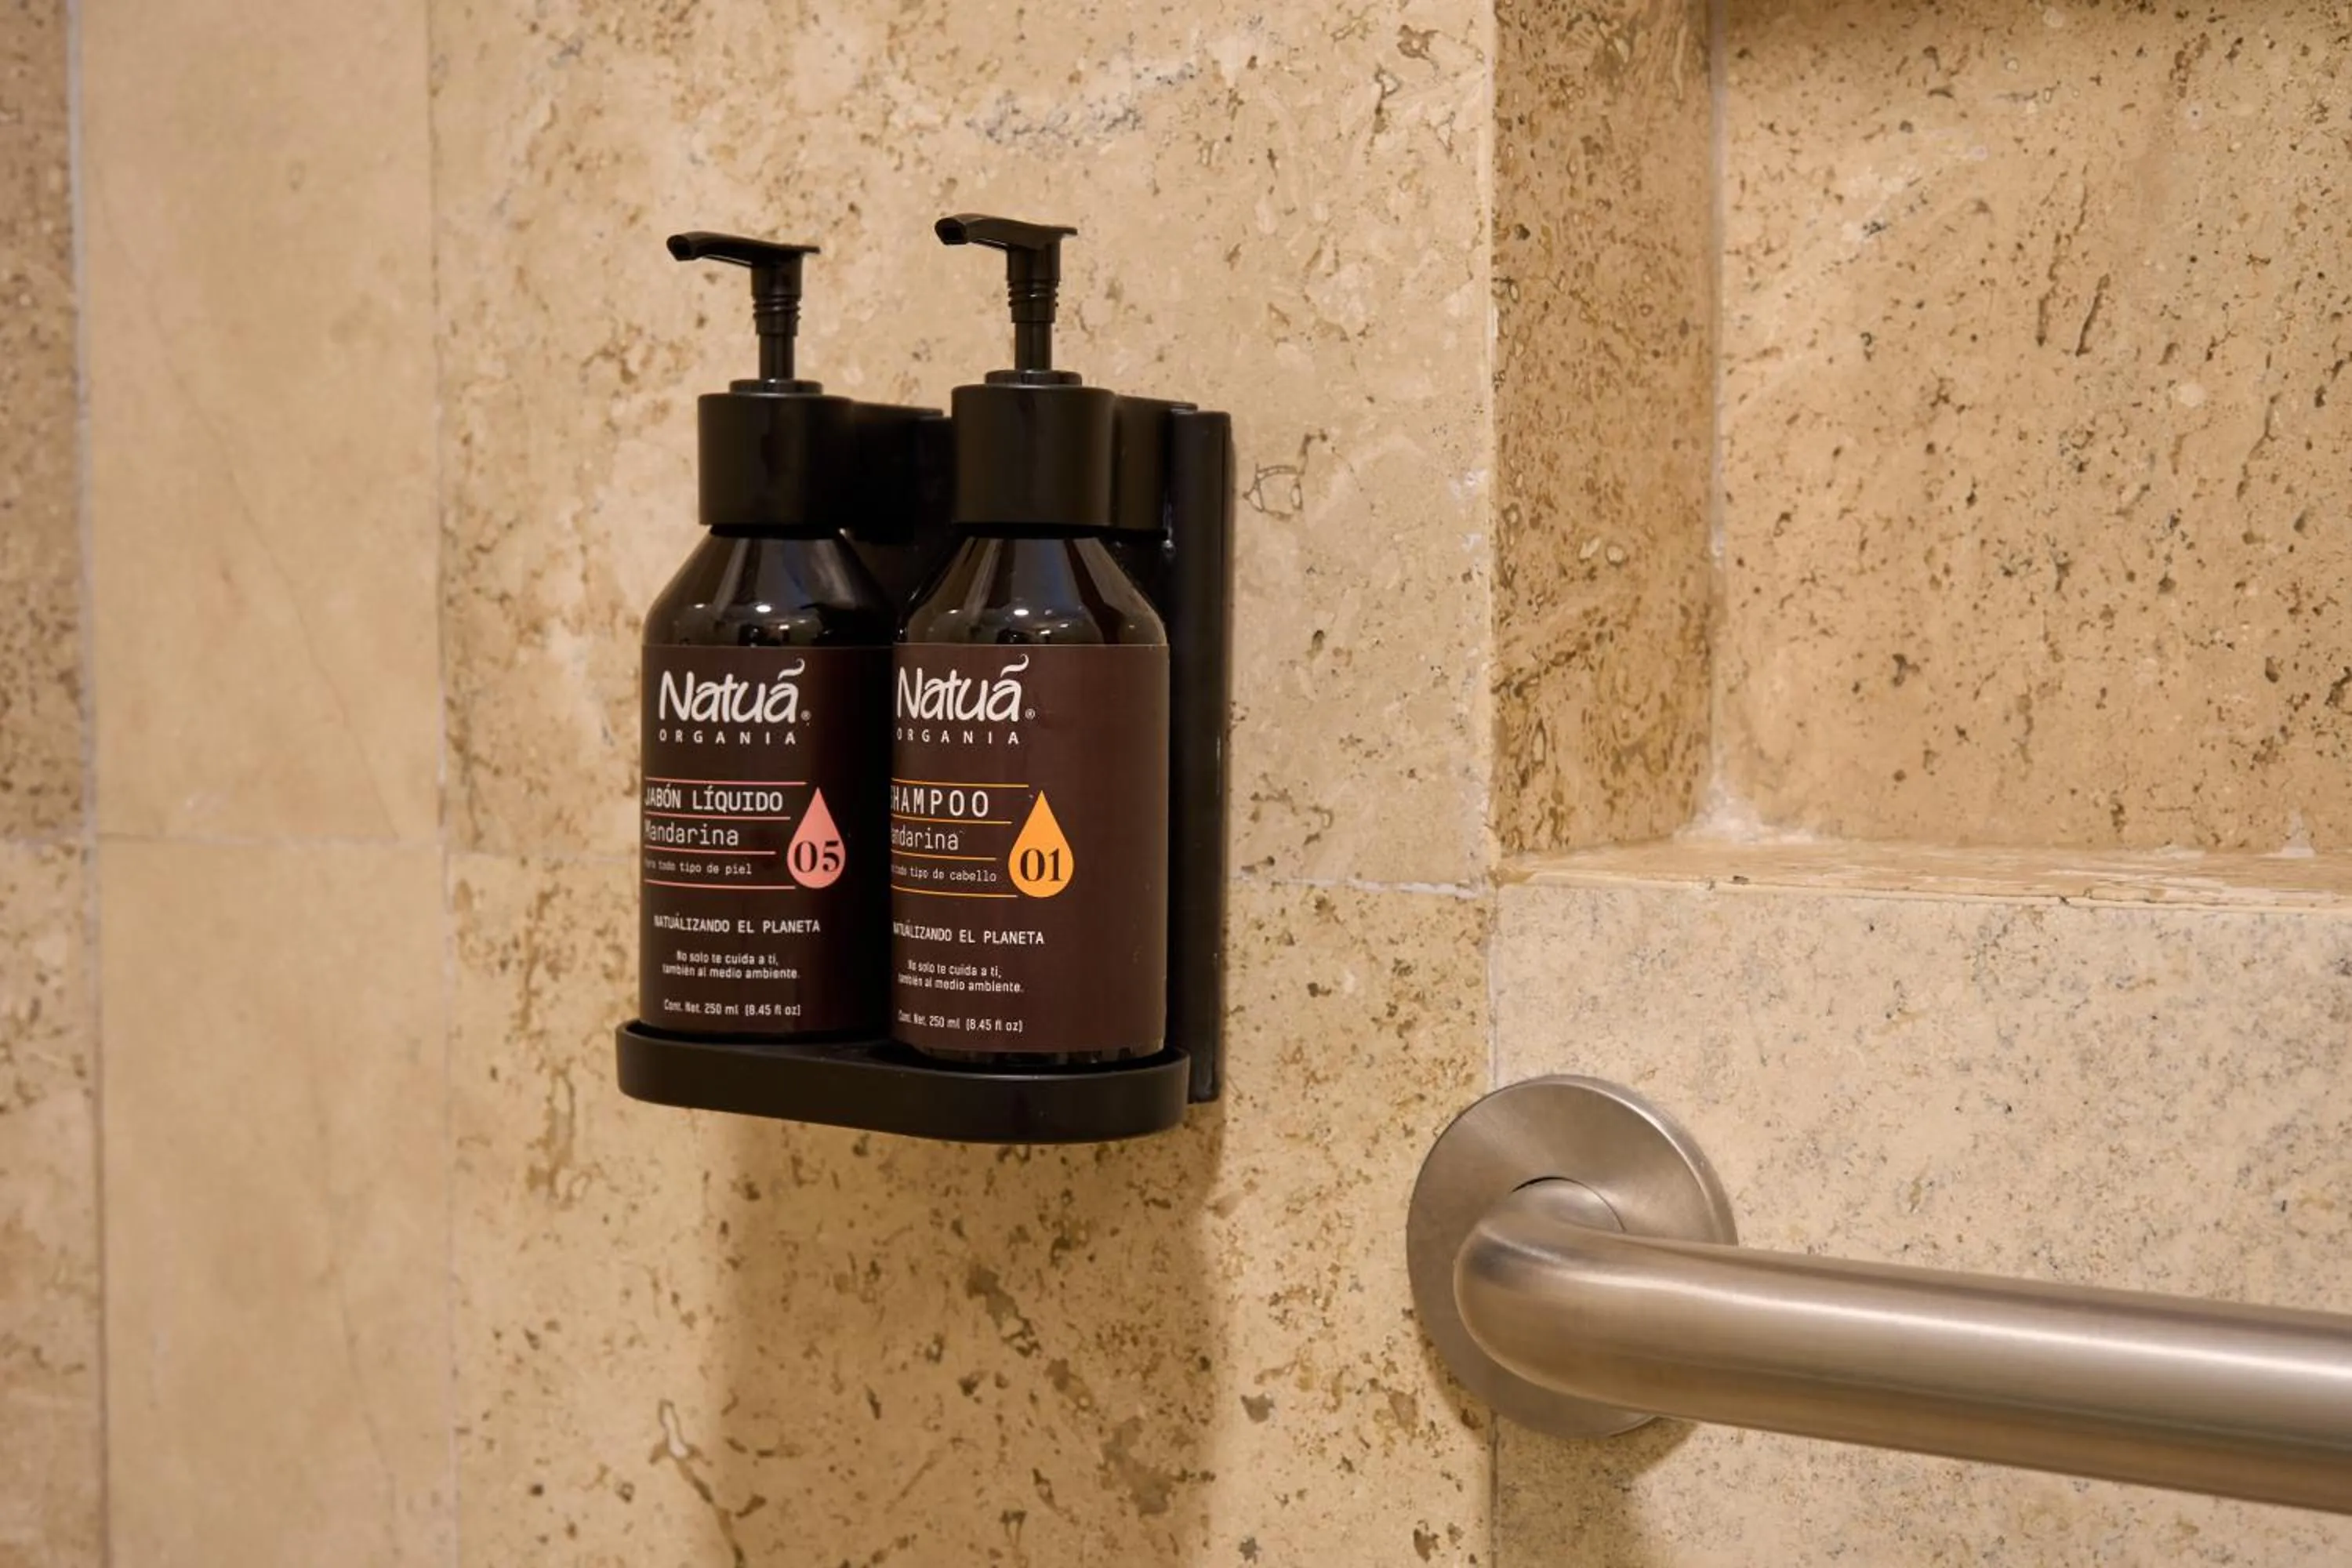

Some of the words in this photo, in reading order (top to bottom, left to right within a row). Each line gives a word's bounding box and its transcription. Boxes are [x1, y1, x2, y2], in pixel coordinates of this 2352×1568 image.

[659, 728, 796, 745] ORGANIA
[896, 727, 1019, 744] ORGANIA
[644, 782, 681, 809] JABÓN
[692, 785, 783, 813] LÍQUIDO
[794, 840, 840, 873] 05
[1020, 848, 1062, 882] 01
[679, 861, 702, 874] tipo
[707, 862, 720, 873] de
[725, 863, 753, 876] piel
[910, 866, 929, 879] tipo
[932, 867, 945, 879] de
[949, 868, 997, 883] cabello
[737, 920, 755, 934] EL
[762, 920, 821, 934] PLANETA
[958, 928, 976, 944] EL
[983, 930, 1046, 946] PLANETA
[677, 950, 687, 962] No
[689, 951, 710, 964] solo
[711, 953, 722, 964] te
[724, 953, 755, 965] cuida
[758, 955, 765, 965] a
[697, 965, 706, 978] al
[710, 967, 742, 979] medio
[746, 967, 800, 979] ambiente.
[907, 959, 916, 971] No
[918, 961, 935, 975] solo
[937, 963, 946, 975] te
[948, 964, 978, 977] cuida
[981, 966, 988, 977] a
[924, 977, 933, 989] al
[935, 978, 966, 992] medio
[967, 979, 1025, 993] ambiente.
[705, 1003, 722, 1015] 250
[724, 1004, 739, 1015] ml
[774, 1004, 782, 1015] fl
[929, 1015, 945, 1028] 250
[946, 1017, 961, 1029] ml
[965, 1018, 993, 1032] (8.45
[995, 1018, 1003, 1031] fl
[1006, 1019, 1024, 1033] oz)
